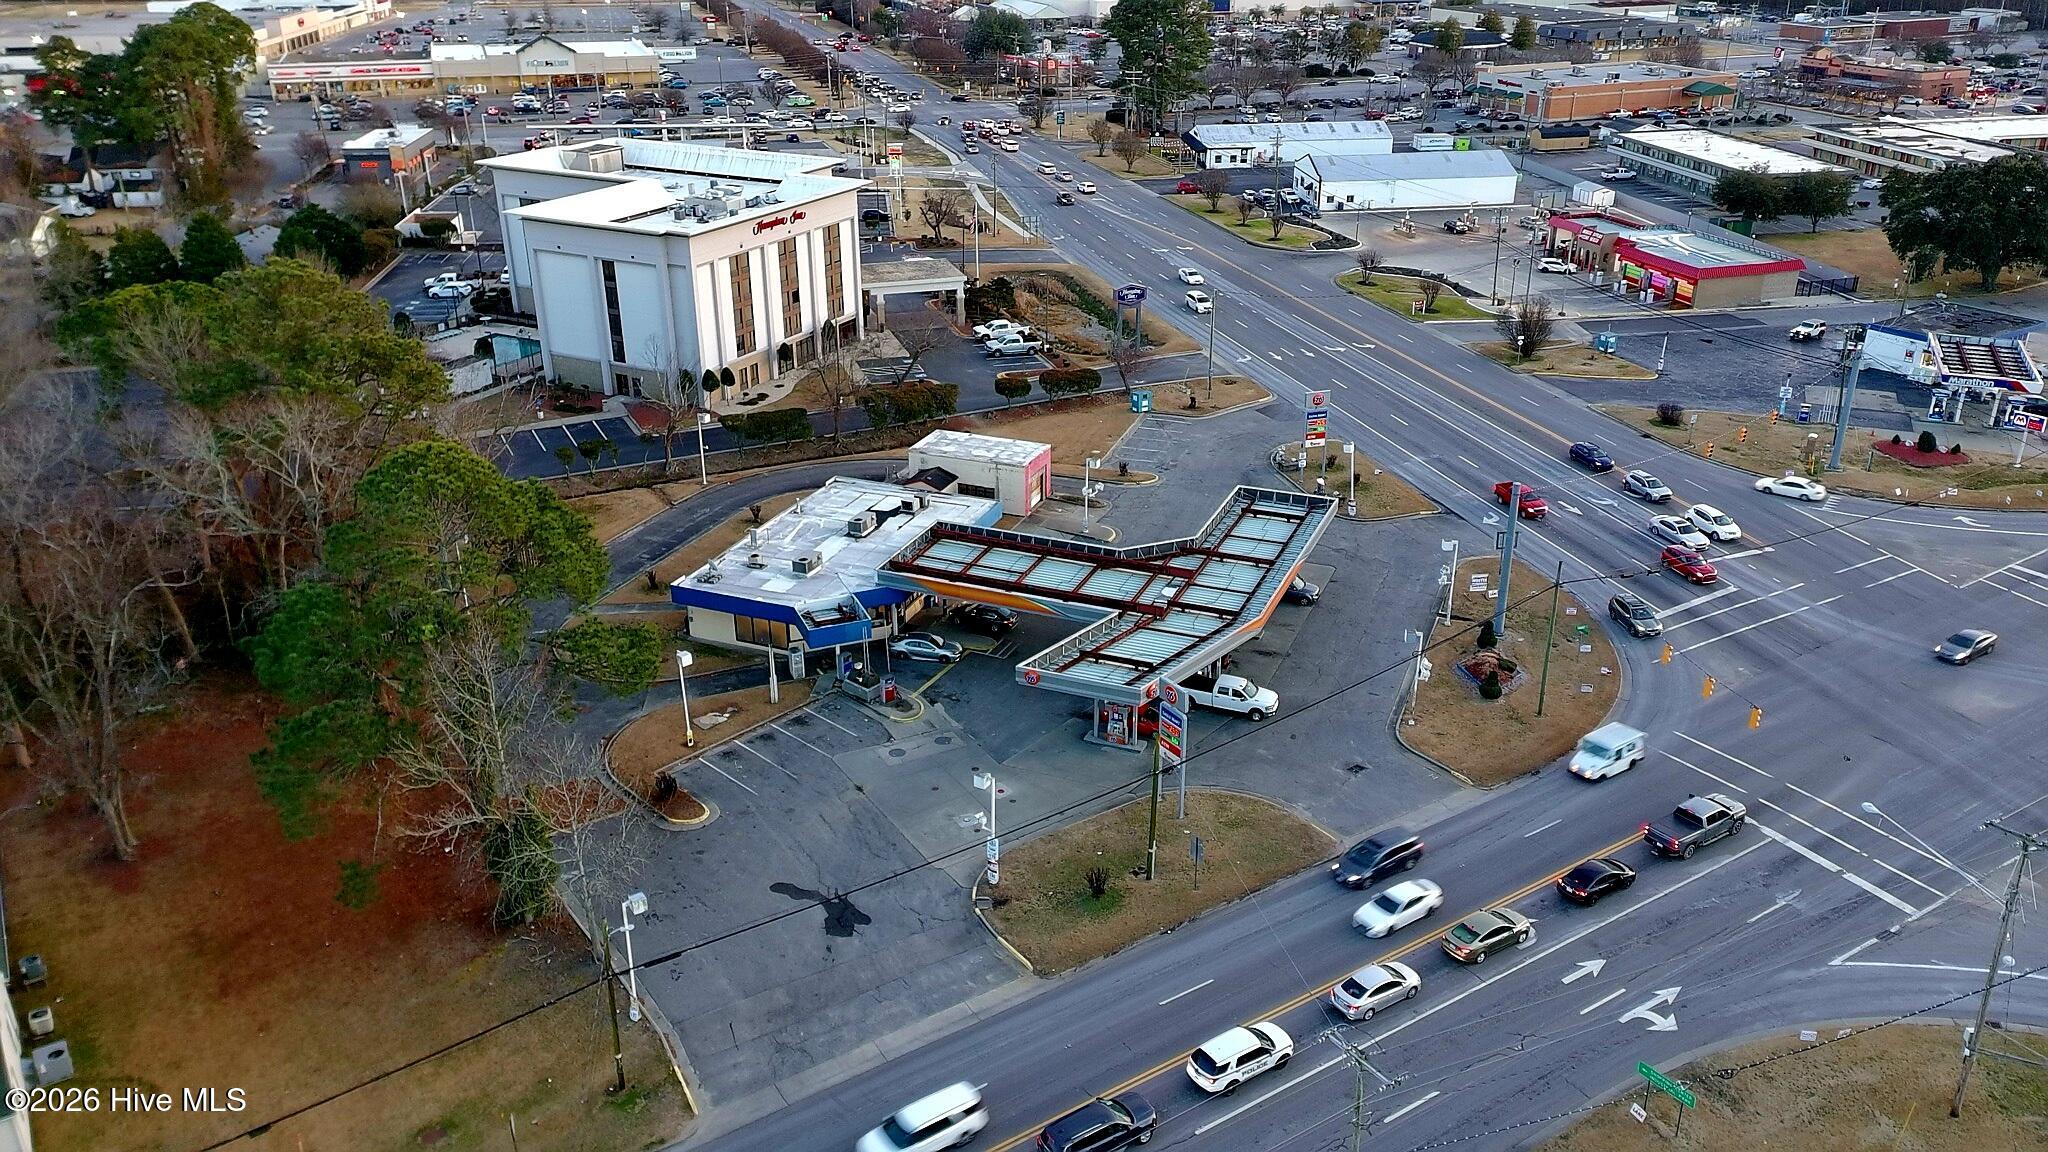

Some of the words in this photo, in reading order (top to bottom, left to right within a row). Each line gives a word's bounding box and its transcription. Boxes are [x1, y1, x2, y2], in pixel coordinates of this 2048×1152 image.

[753, 216, 788, 235] Hampton
[1948, 376, 1995, 387] Marathon
[1165, 690, 1177, 702] 76
[1241, 1060, 1269, 1077] POLICE
[1632, 1106, 1645, 1119] LANE
